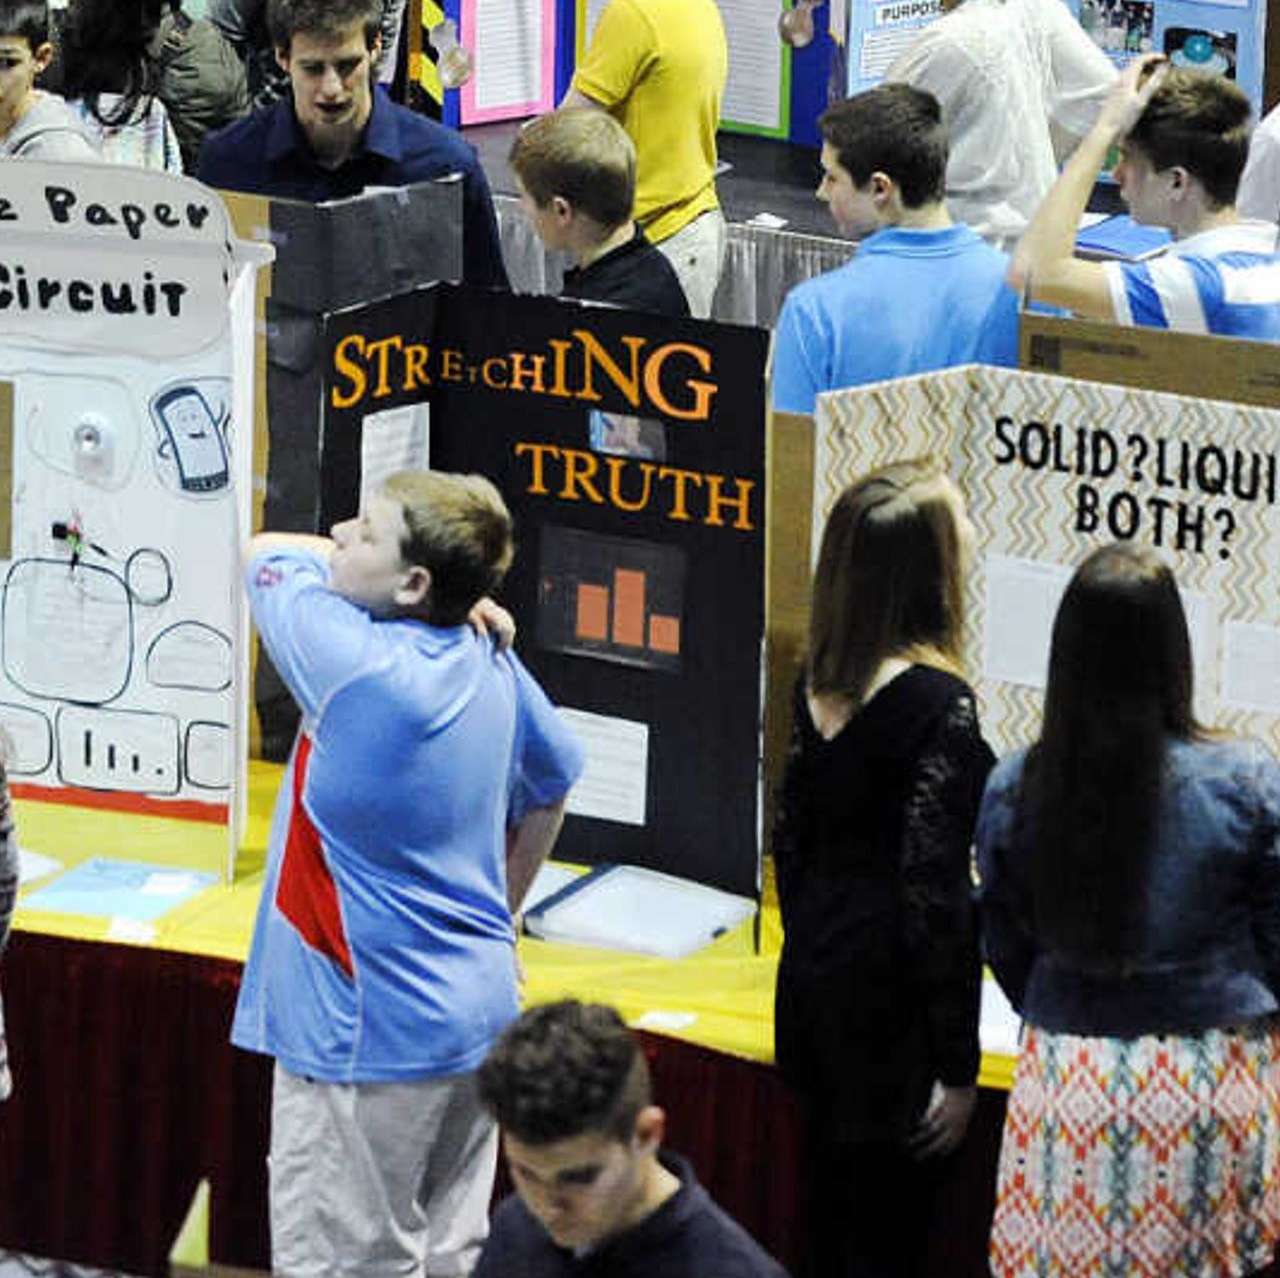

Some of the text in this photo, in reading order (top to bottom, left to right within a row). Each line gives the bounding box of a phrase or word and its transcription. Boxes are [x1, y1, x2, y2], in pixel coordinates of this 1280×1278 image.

[45, 185, 209, 241] Paper
[330, 329, 719, 421] STRETCHING
[514, 441, 757, 532] TRUTH
[1076, 487, 1236, 560] BOTH?
